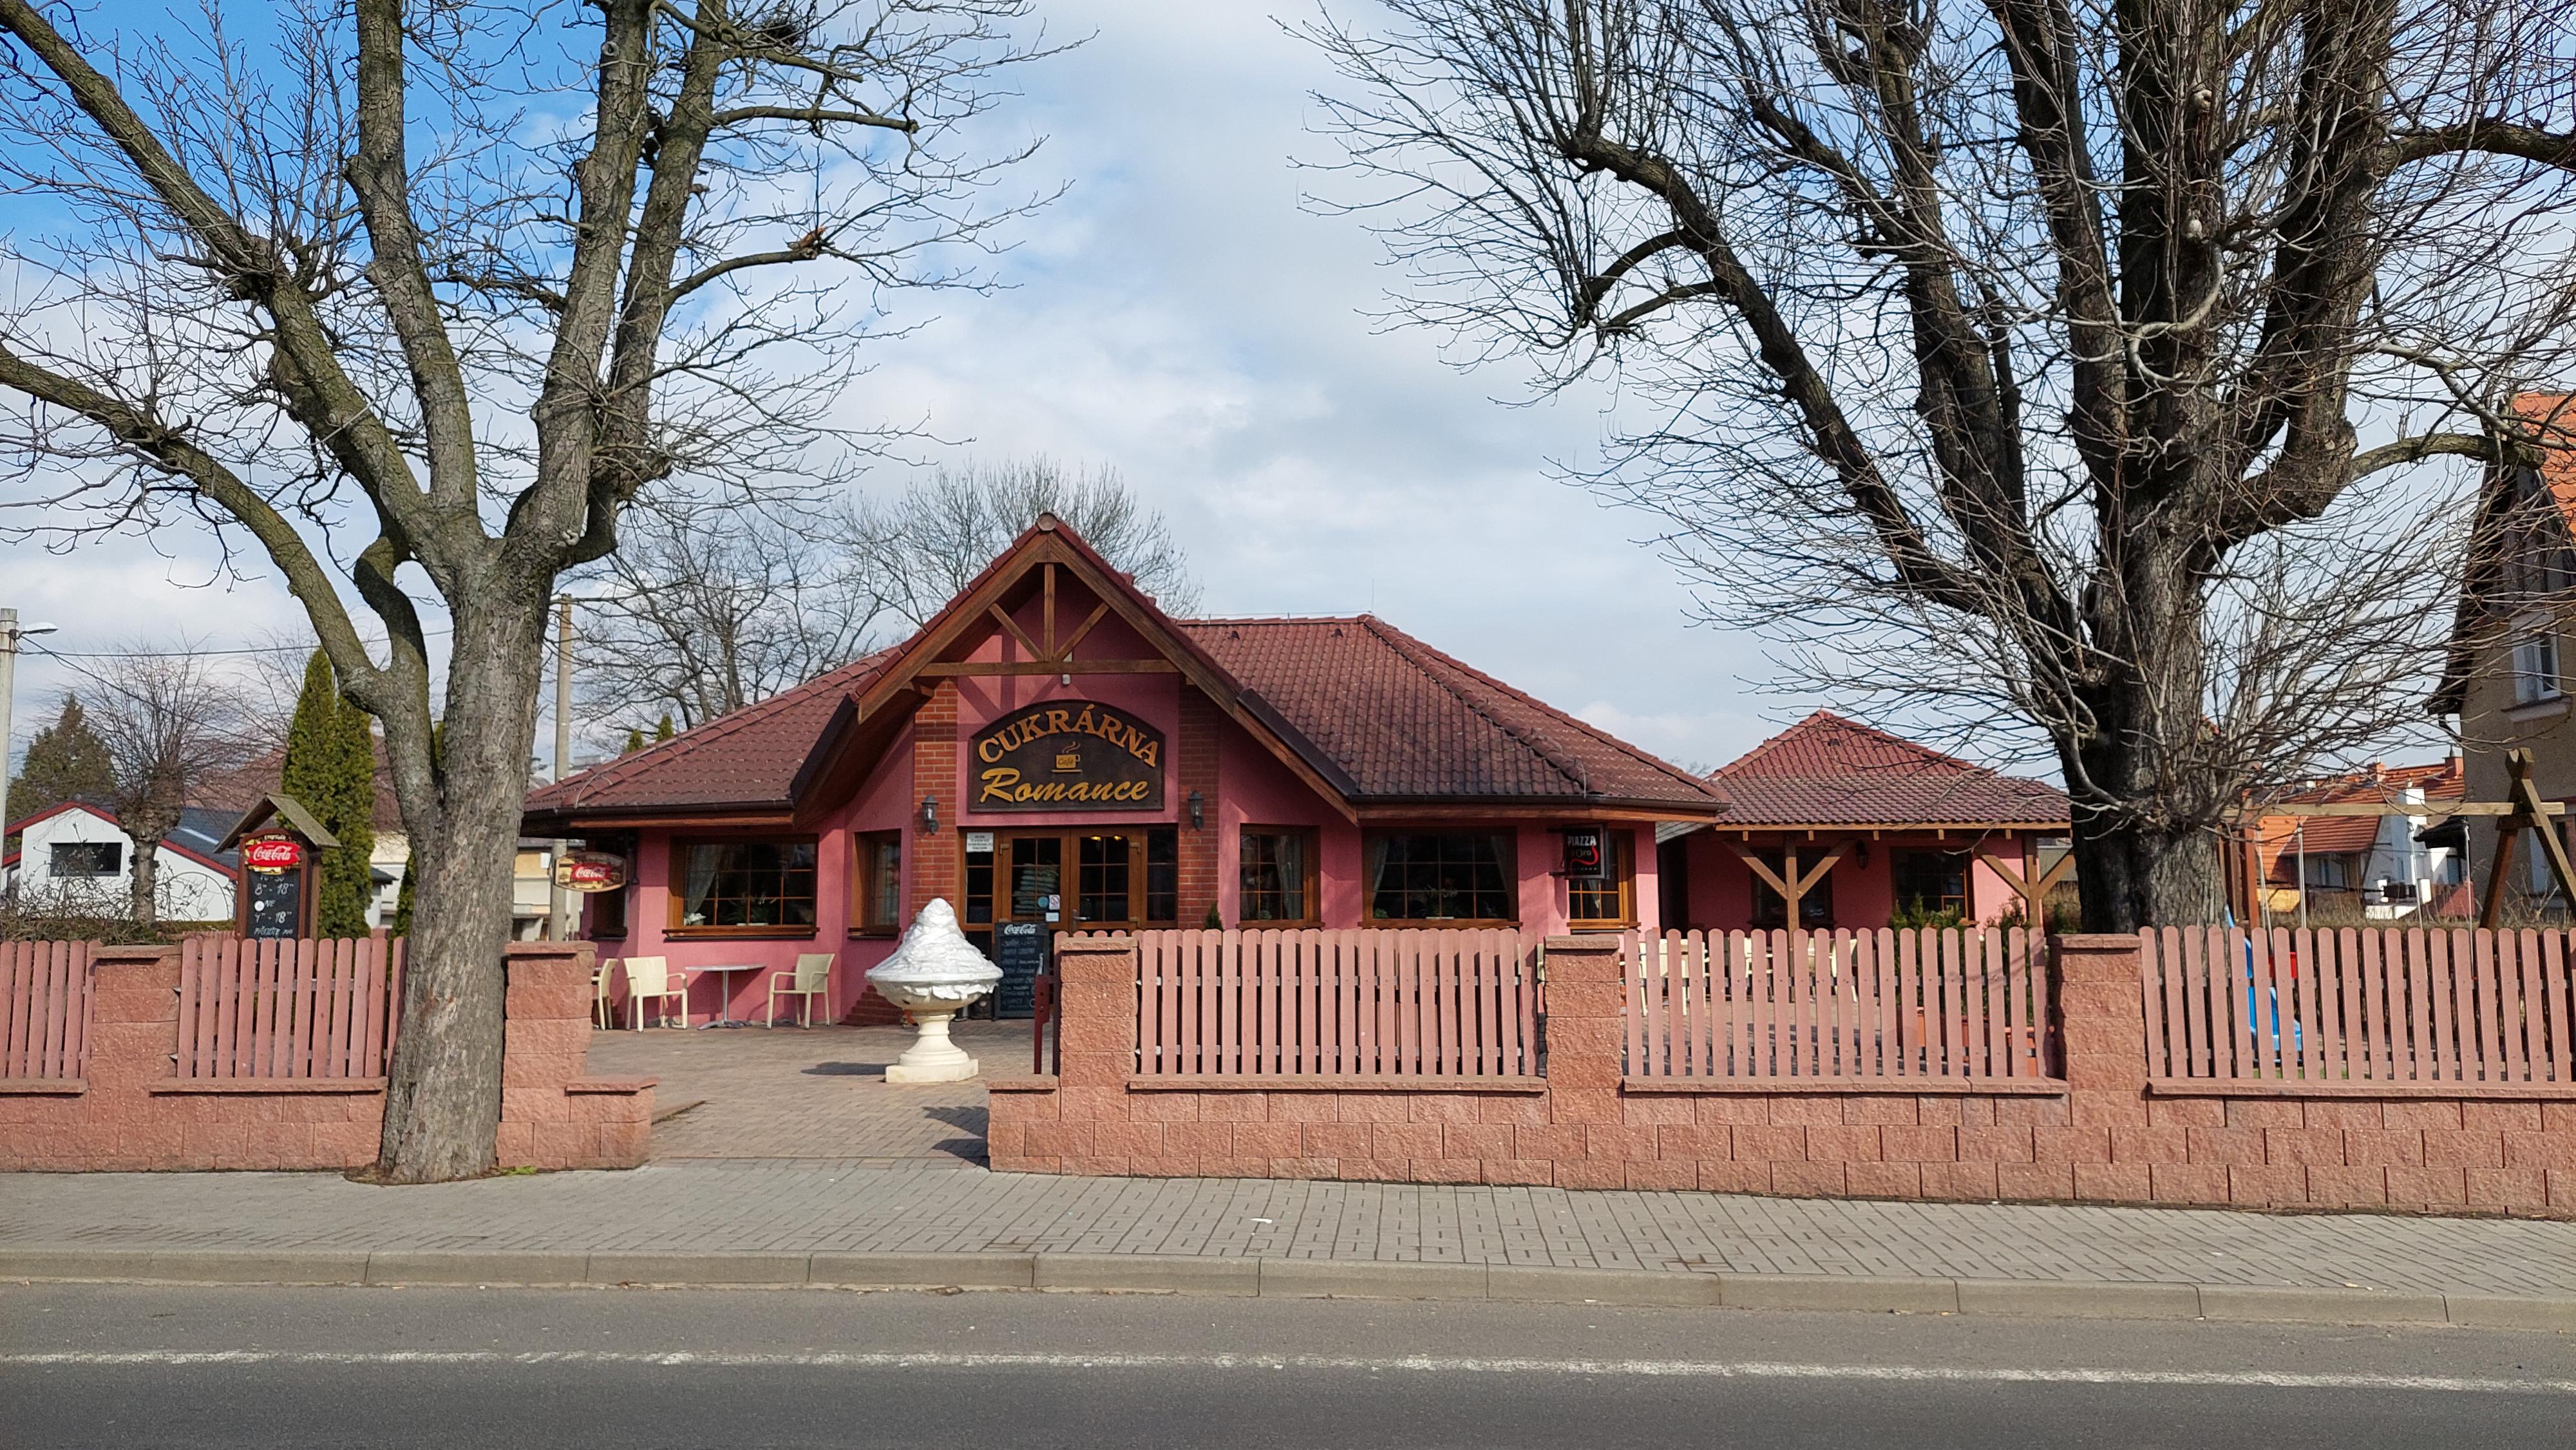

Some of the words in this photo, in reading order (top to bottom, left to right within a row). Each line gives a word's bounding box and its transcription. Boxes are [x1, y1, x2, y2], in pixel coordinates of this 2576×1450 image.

[979, 704, 1158, 767] CUKRÁRNA
[980, 767, 1149, 802] Romance
[1567, 835, 1596, 846] PIAZZA
[253, 845, 292, 862] Coca-Cola
[575, 866, 606, 878] Coca-Cola
[1004, 923, 1036, 935] Coca-Cola
